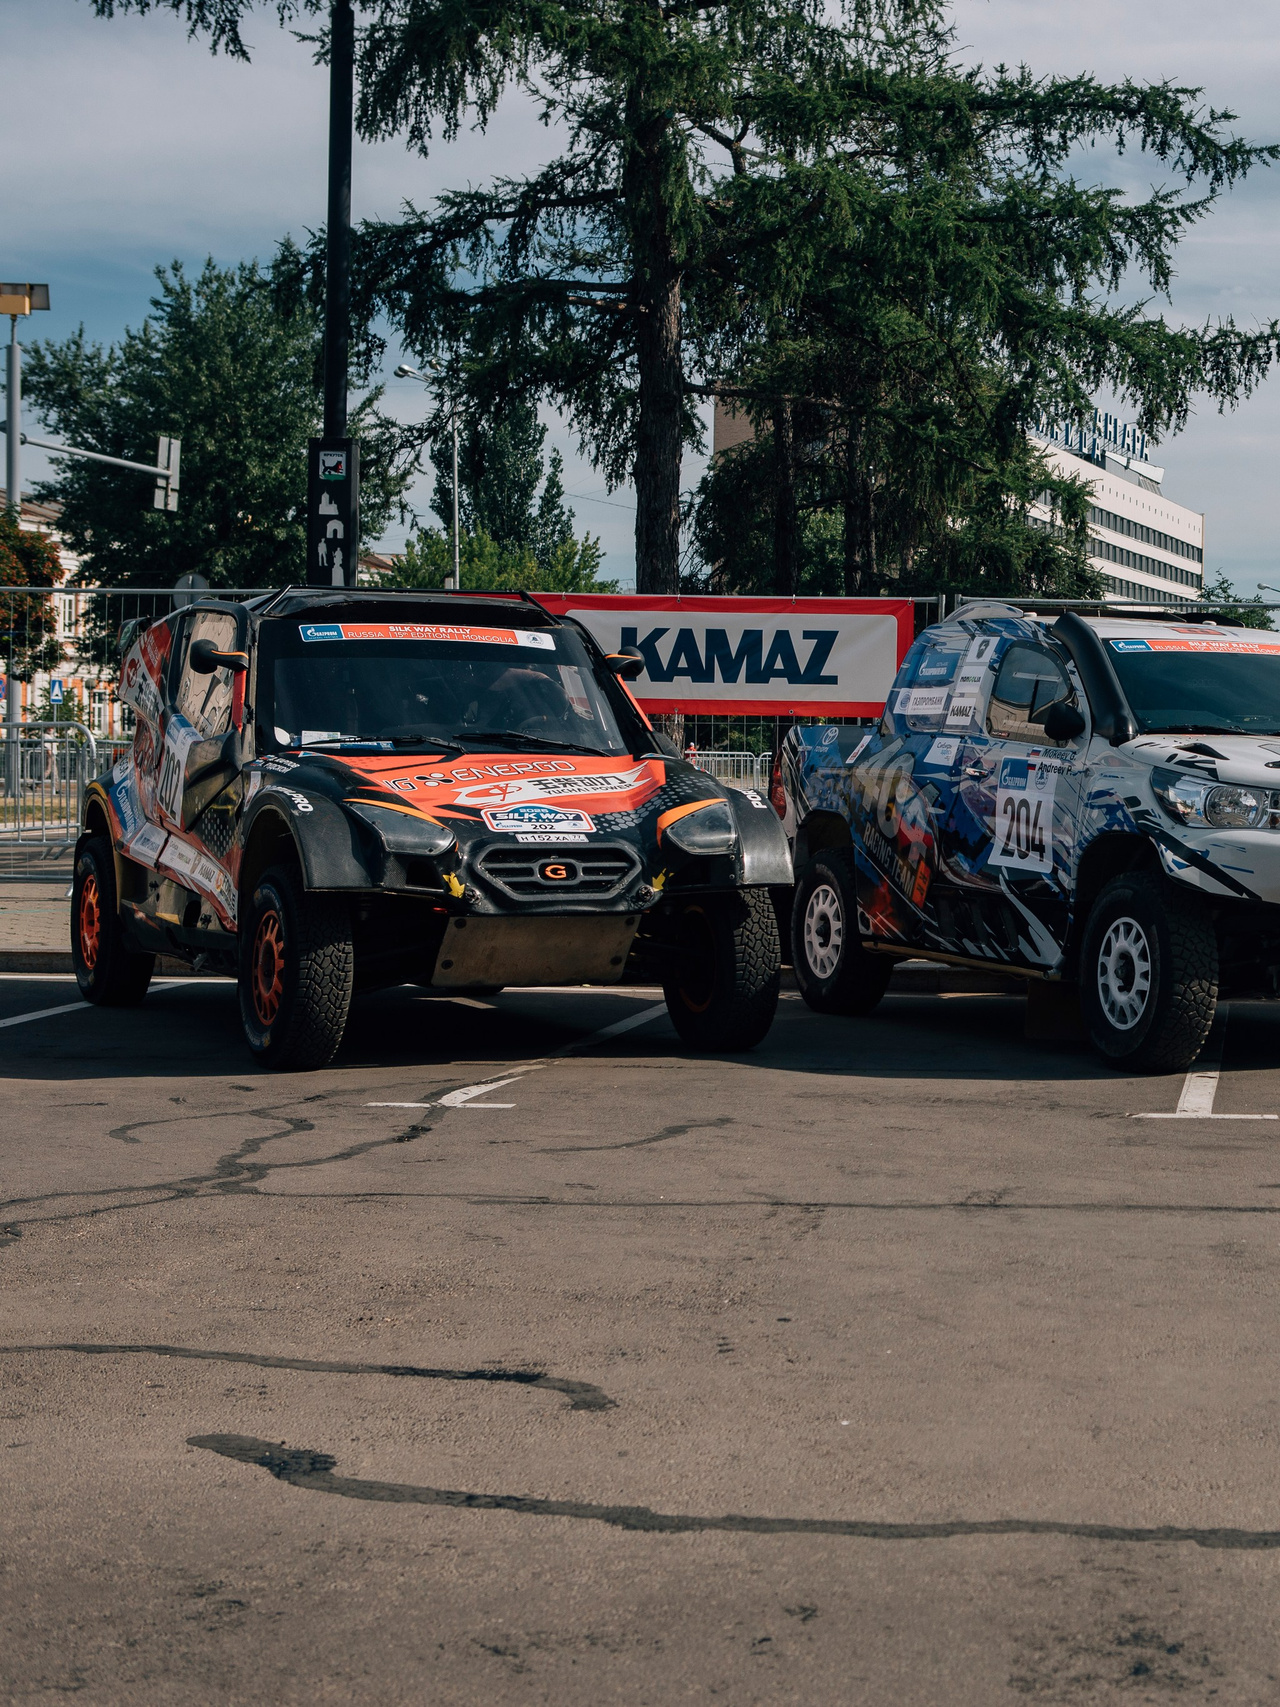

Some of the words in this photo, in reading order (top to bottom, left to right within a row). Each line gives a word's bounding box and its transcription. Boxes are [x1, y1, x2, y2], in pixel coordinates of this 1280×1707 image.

[410, 631, 450, 639] EDITION
[462, 634, 515, 643] MONGOLIA
[439, 627, 470, 635] RALLY
[620, 627, 839, 685] KAMAZ
[949, 706, 972, 717] KAMAZ
[450, 760, 576, 782] ENERGO
[528, 774, 626, 790] 玉柴动力
[543, 786, 589, 796] YUCHAI
[591, 782, 635, 792] POWER
[495, 812, 536, 820] SILK
[538, 812, 576, 820] WAY
[999, 796, 1046, 862] 204
[863, 821, 893, 870] RACING
[890, 852, 916, 897] TEAM
[544, 864, 567, 879] G
